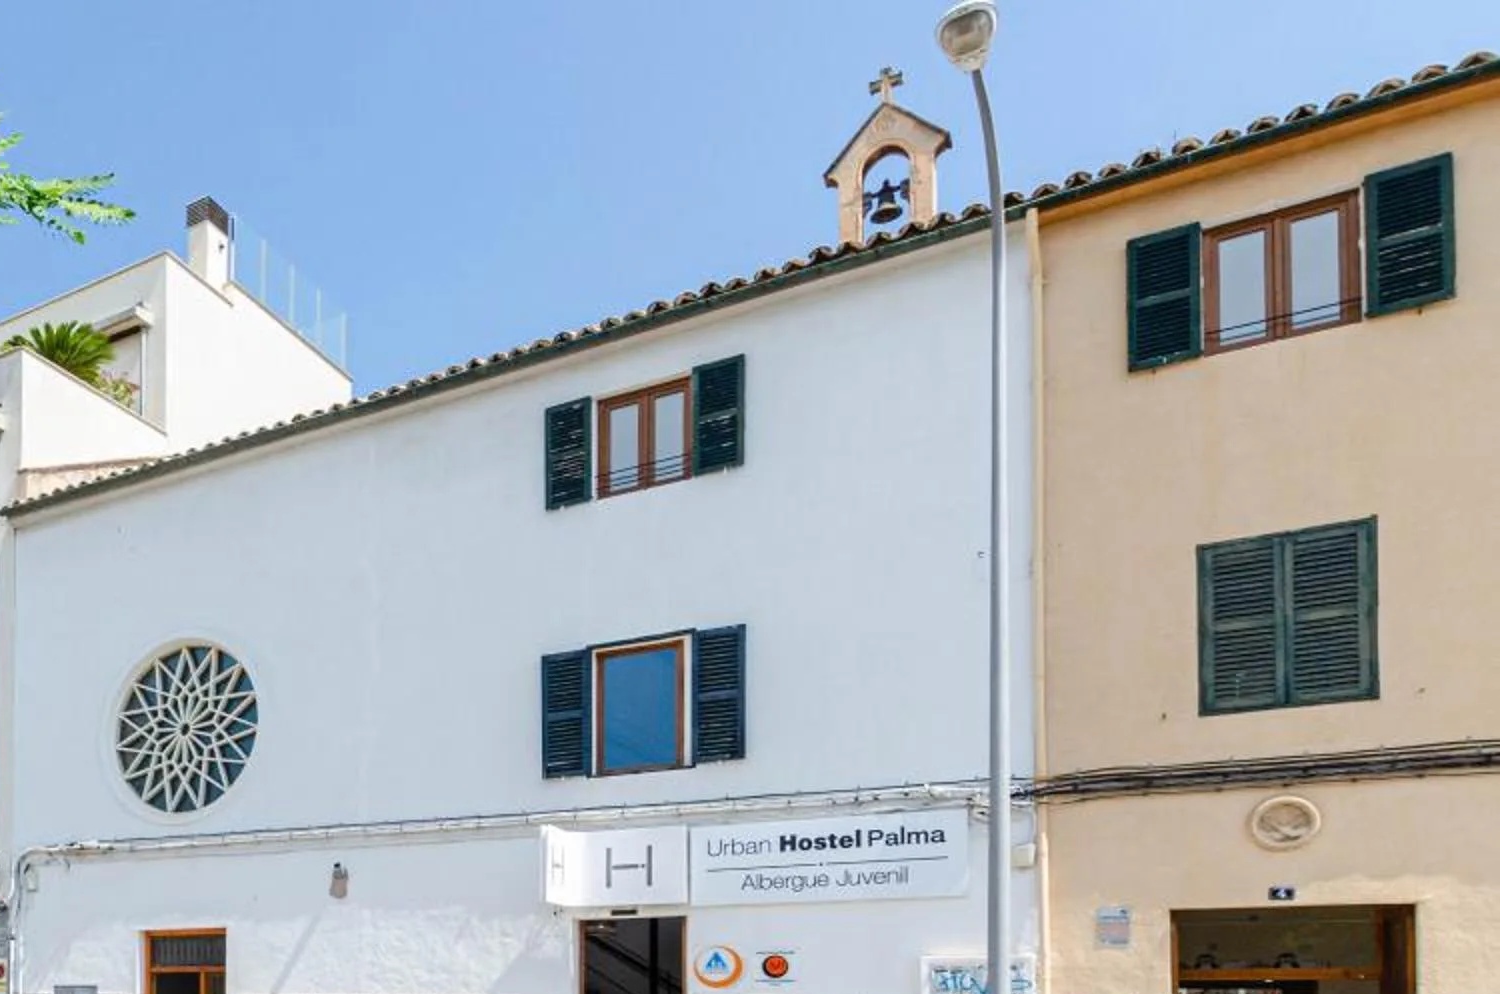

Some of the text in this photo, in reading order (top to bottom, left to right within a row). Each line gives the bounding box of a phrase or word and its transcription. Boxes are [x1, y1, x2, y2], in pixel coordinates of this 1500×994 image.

[706, 825, 947, 857] Urban Hostel Palma
[605, 843, 653, 889] H
[740, 865, 909, 893] Albergue Juvenil
